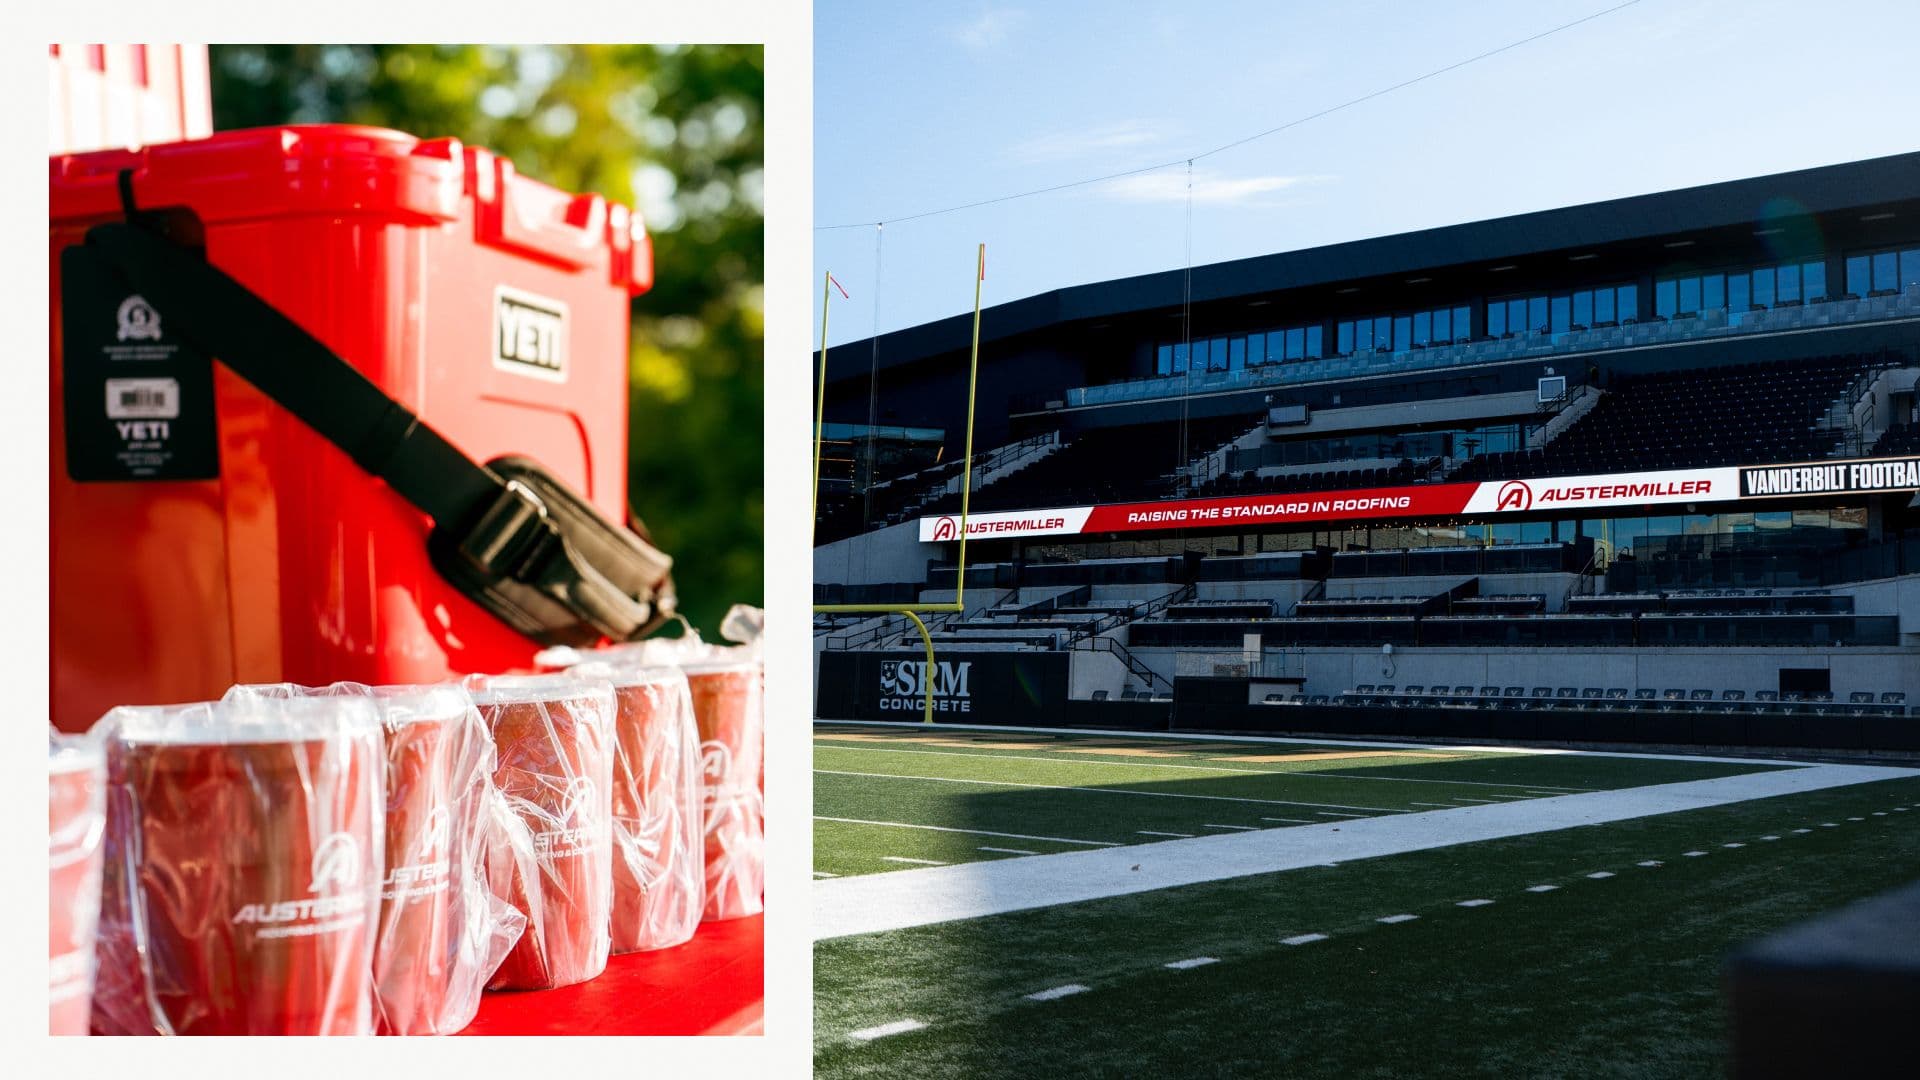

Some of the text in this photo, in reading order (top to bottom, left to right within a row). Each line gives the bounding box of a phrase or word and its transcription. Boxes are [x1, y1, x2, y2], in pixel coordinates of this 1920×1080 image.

[501, 302, 561, 368] YETI
[116, 421, 169, 440] YETI
[1539, 480, 1712, 502] AUSTERMILLER
[1746, 461, 1920, 495] VANDERBILT FOOTBA
[1128, 496, 1411, 523] RAISING THE STANDARD IN ROOFING
[896, 660, 972, 697] SRM
[880, 698, 971, 712] CONCRETE
